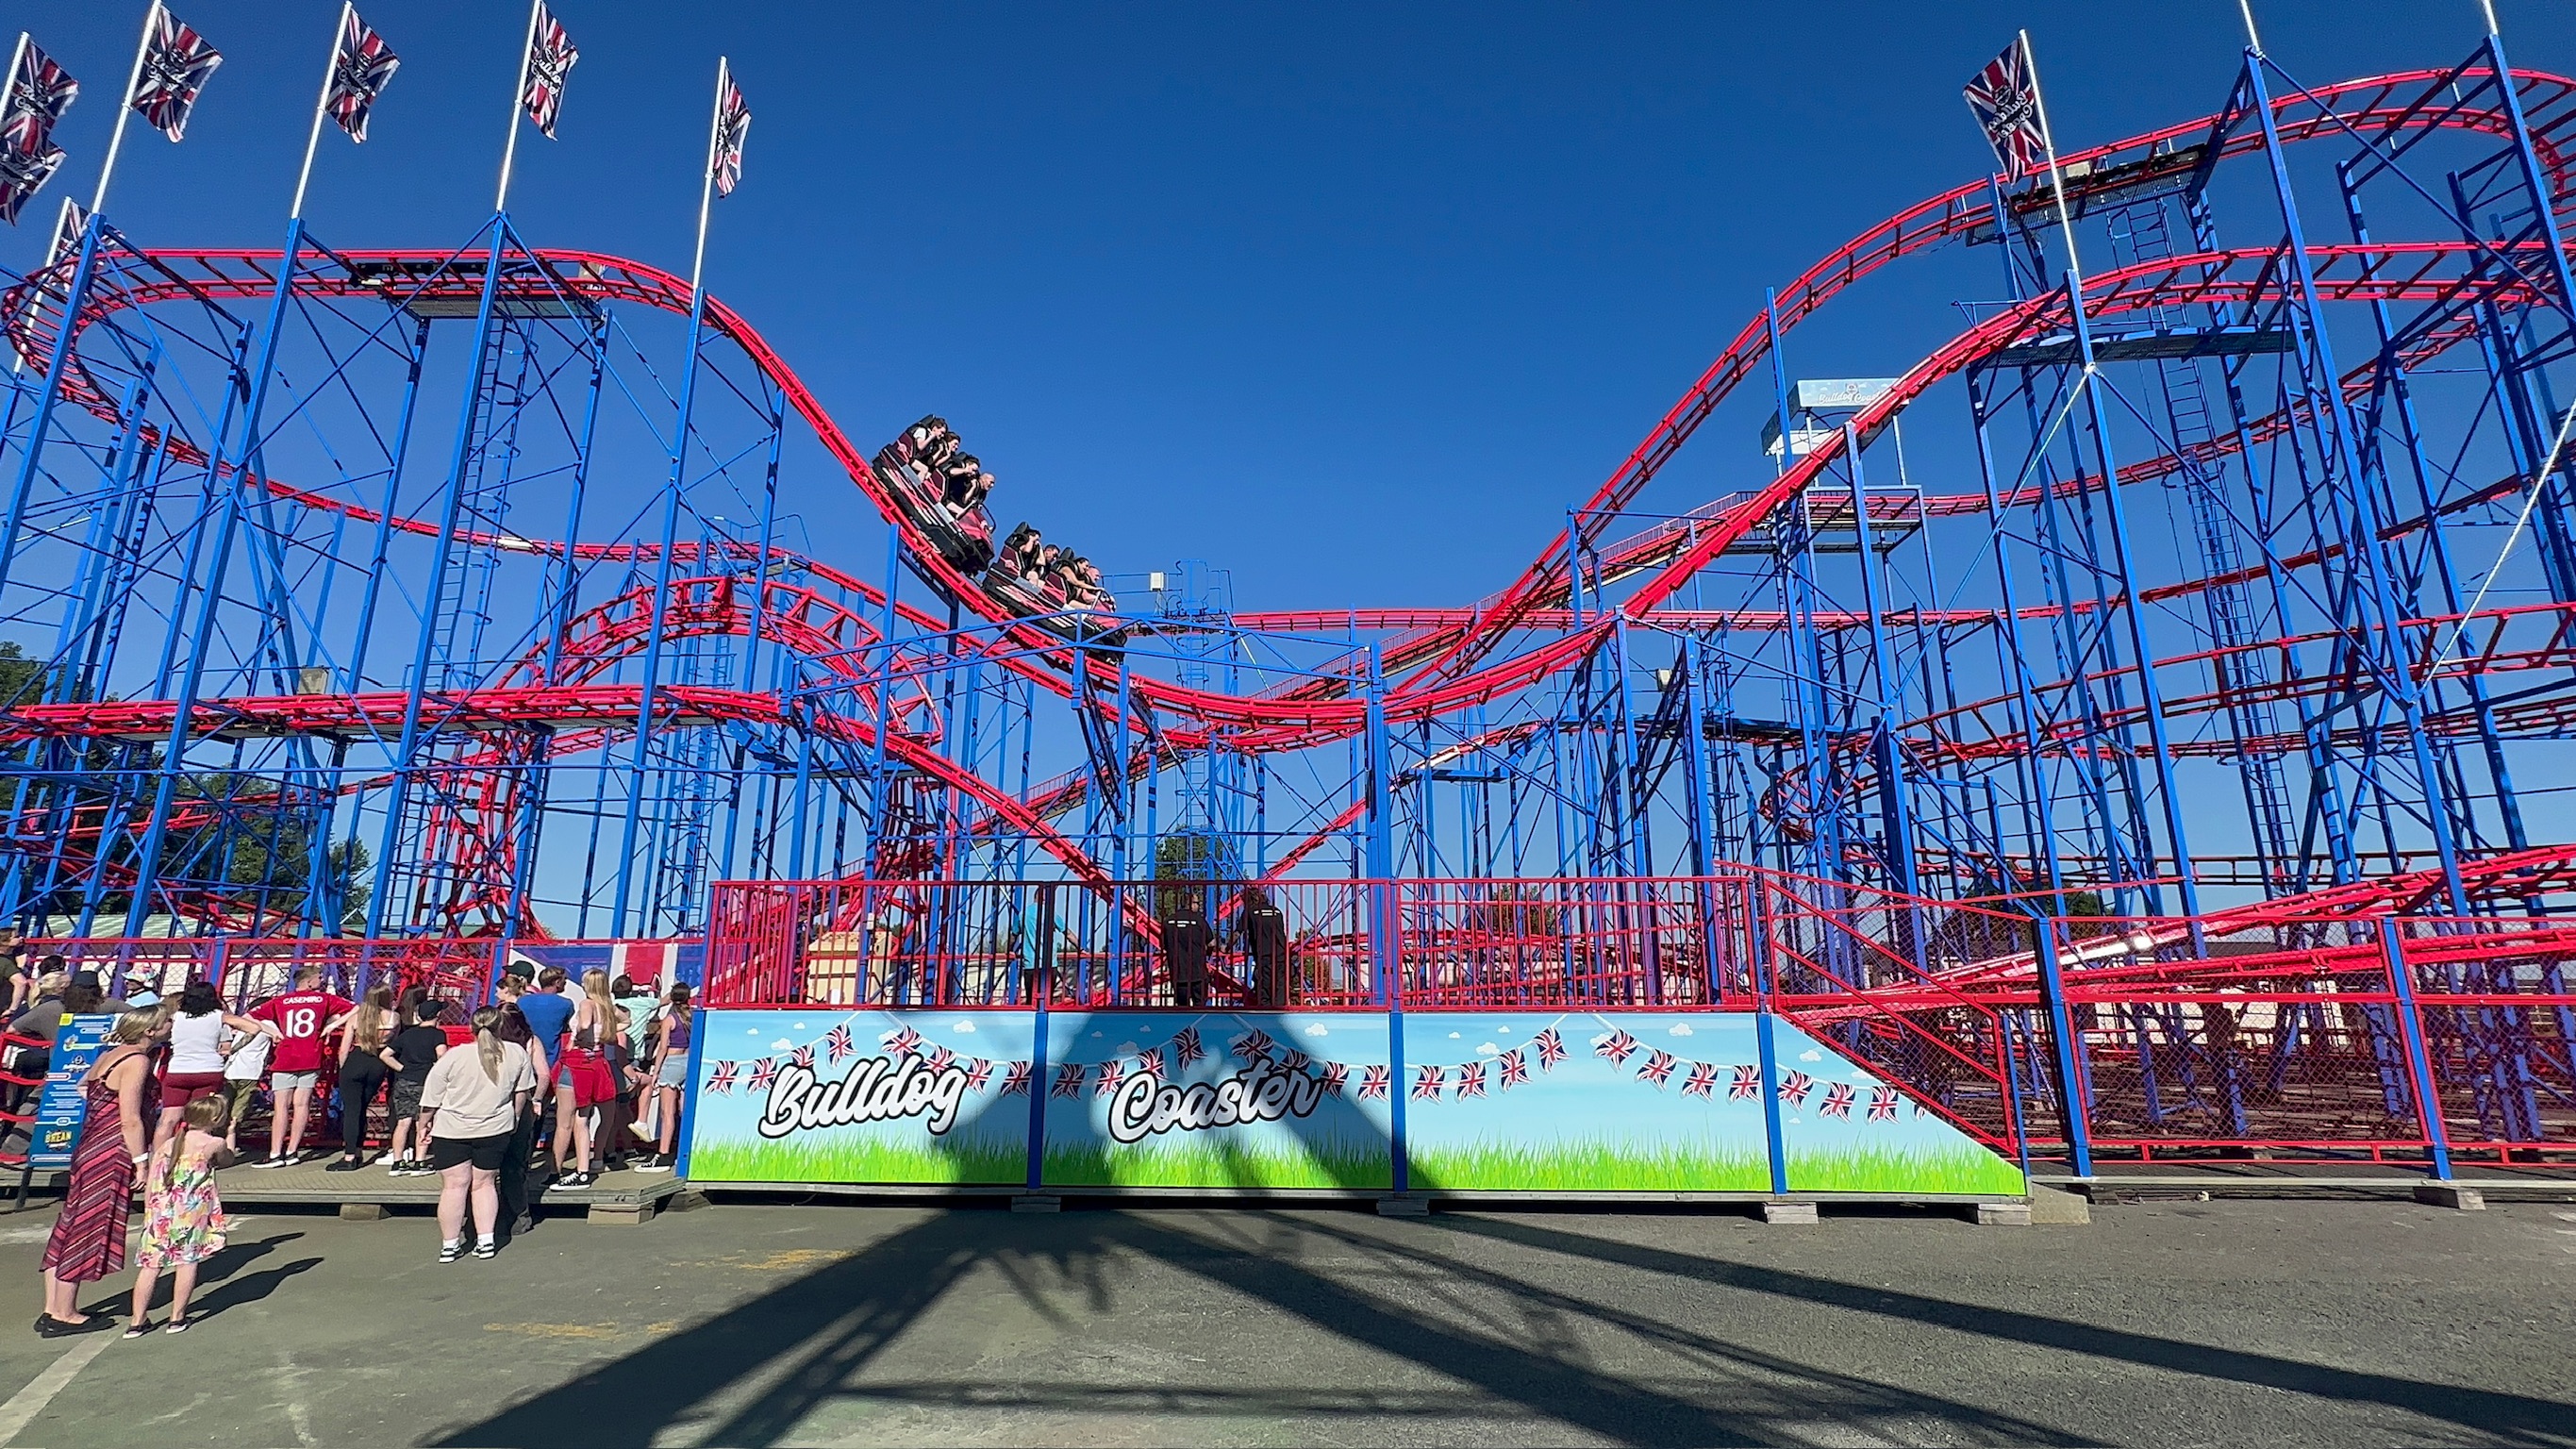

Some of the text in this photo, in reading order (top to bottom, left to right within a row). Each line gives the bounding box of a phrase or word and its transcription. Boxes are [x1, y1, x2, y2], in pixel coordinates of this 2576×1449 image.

[1819, 391, 1853, 404] Bulldog
[283, 995, 324, 1005] CASEMIRO
[286, 1008, 316, 1038] 18
[758, 1052, 1322, 1143] Bulldog Coaster
